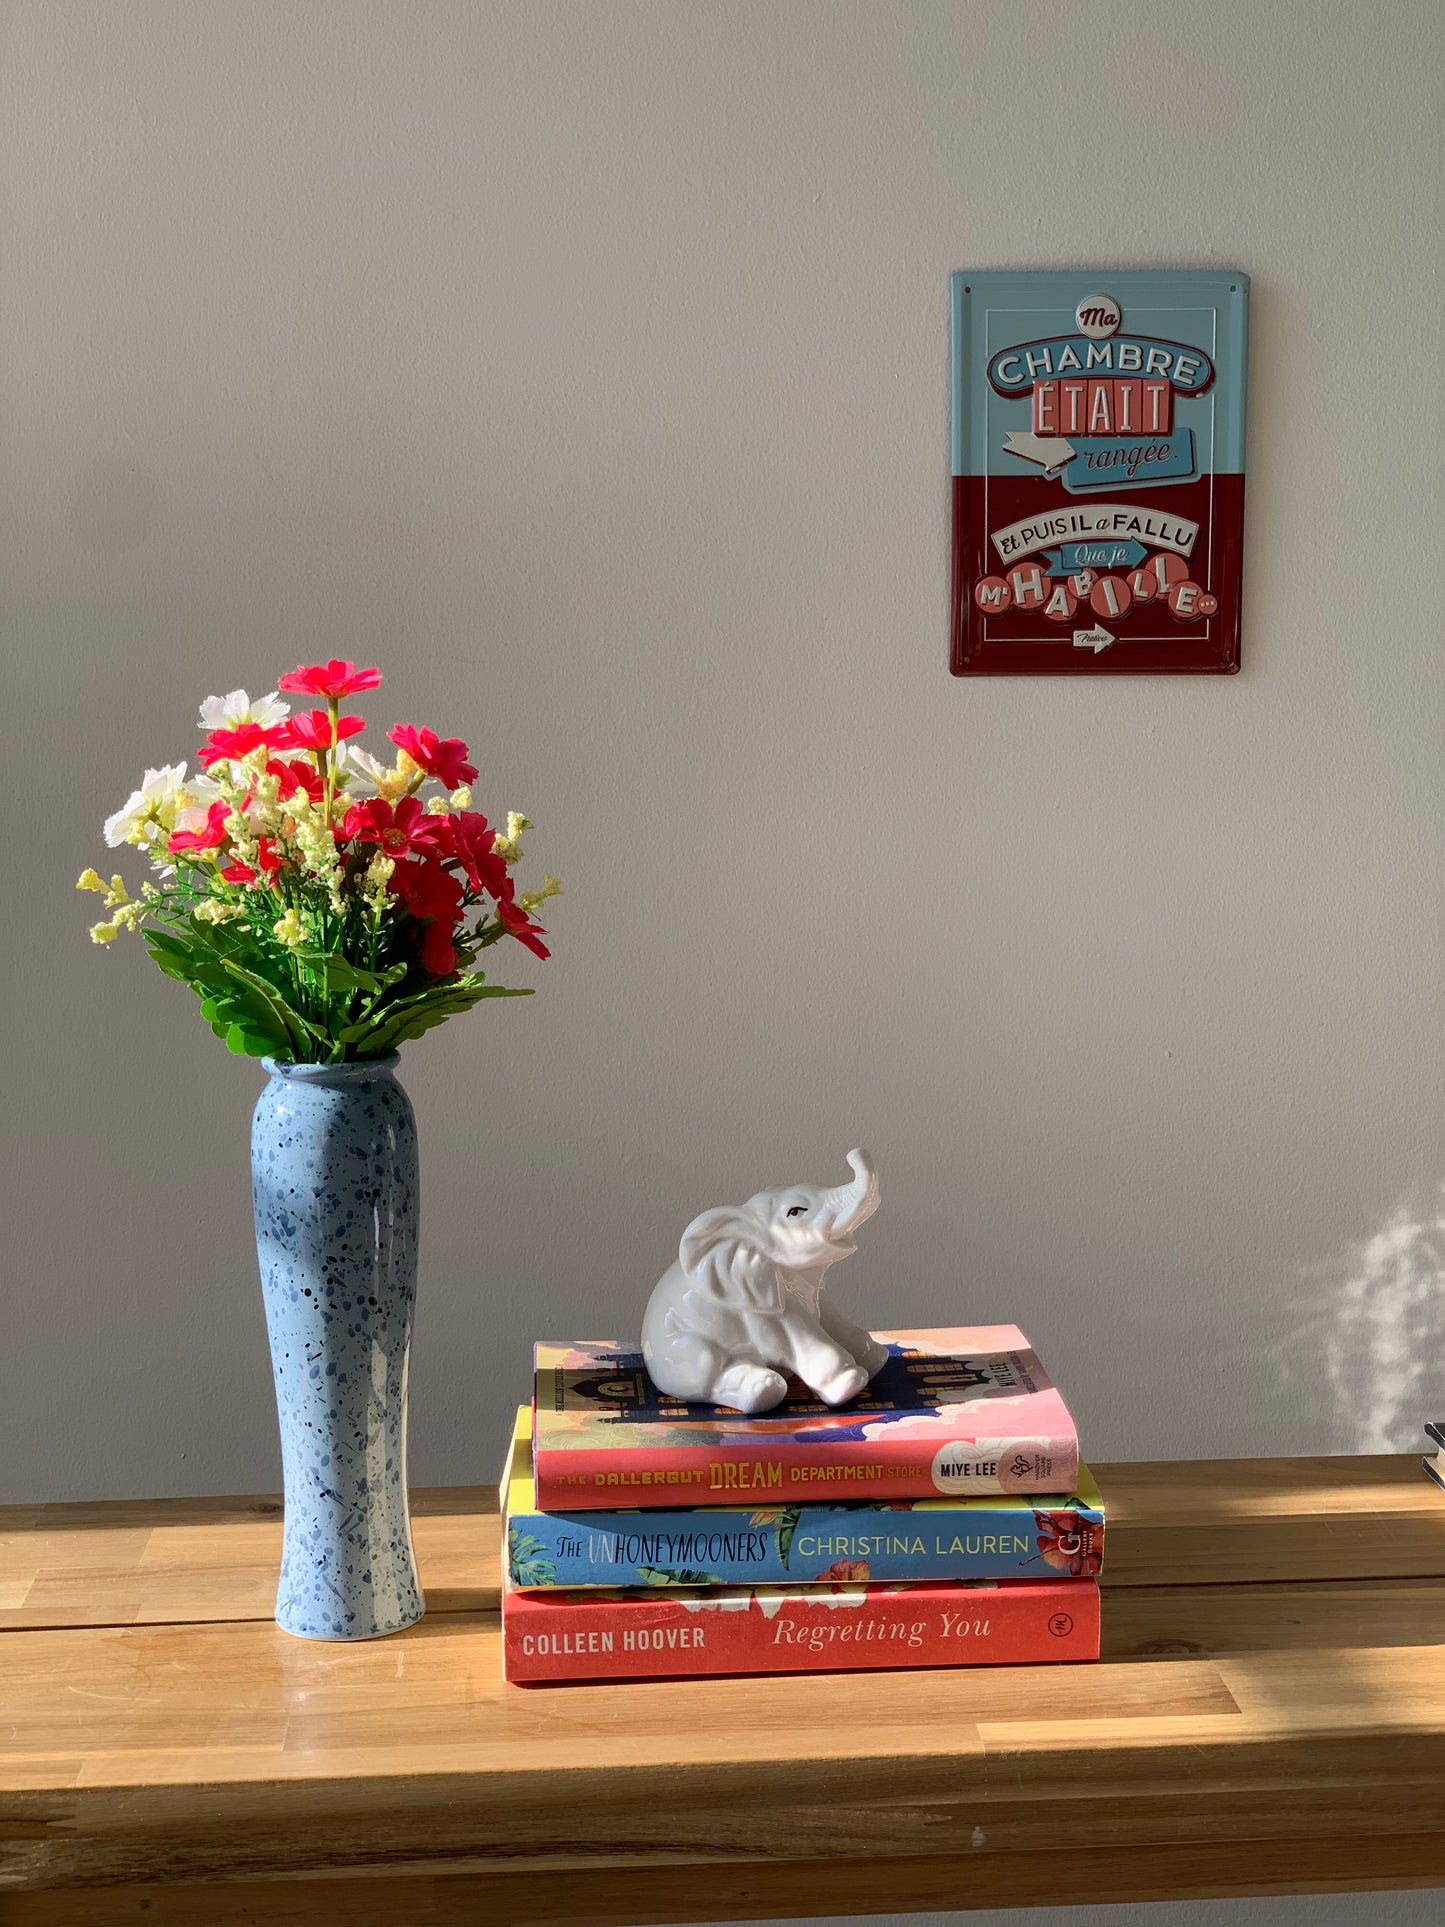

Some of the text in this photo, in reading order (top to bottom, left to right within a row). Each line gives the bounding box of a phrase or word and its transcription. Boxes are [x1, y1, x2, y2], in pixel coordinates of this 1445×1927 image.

[1079, 307, 1118, 327] Ma
[998, 343, 1201, 385] CHAMBRE
[1038, 382, 1165, 432] ÉTAIT
[1000, 514, 1193, 555] Et PUIS IL a FALLU
[1074, 543, 1128, 569] Que je
[989, 1363, 1010, 1373] LEE
[555, 1462, 922, 1489] THE DALLERGUT DREAM DEPARTMENT STORE
[940, 1462, 997, 1477] MIYE LEE
[557, 1532, 768, 1565] THE UNHONEYMOONERS
[798, 1535, 1029, 1556] CHRISTINA LAUREN
[522, 1628, 705, 1656] COLLEEN HOOVER
[772, 1610, 992, 1651] Regretting You
